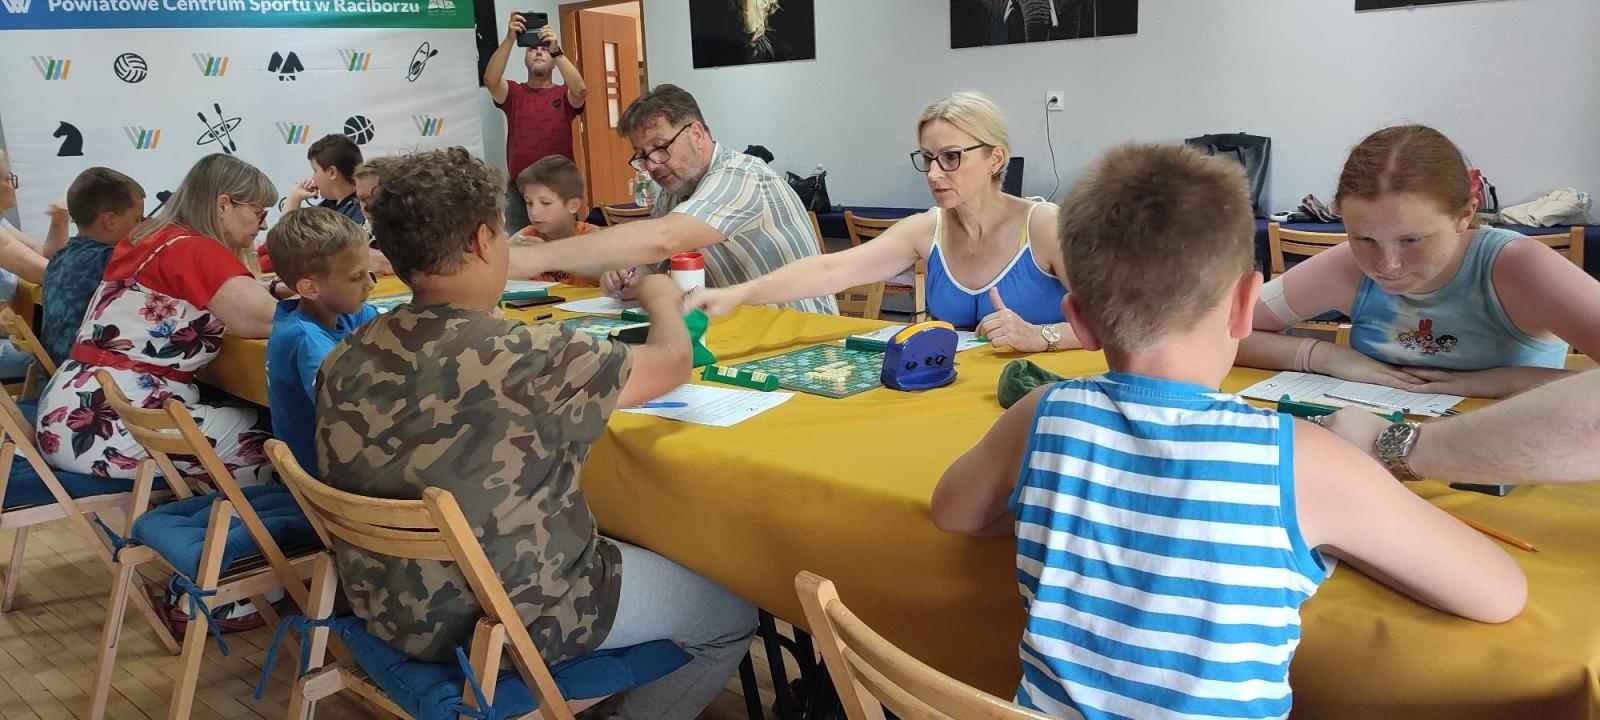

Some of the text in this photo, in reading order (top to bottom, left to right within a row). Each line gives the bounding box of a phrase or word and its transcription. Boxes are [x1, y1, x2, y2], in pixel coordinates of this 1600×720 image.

[48, 0, 159, 12] Powiatowe
[162, 0, 246, 11] Centrum
[249, 0, 311, 14] Sportu
[313, 1, 330, 12] w
[333, 0, 420, 13] Raciborzu
